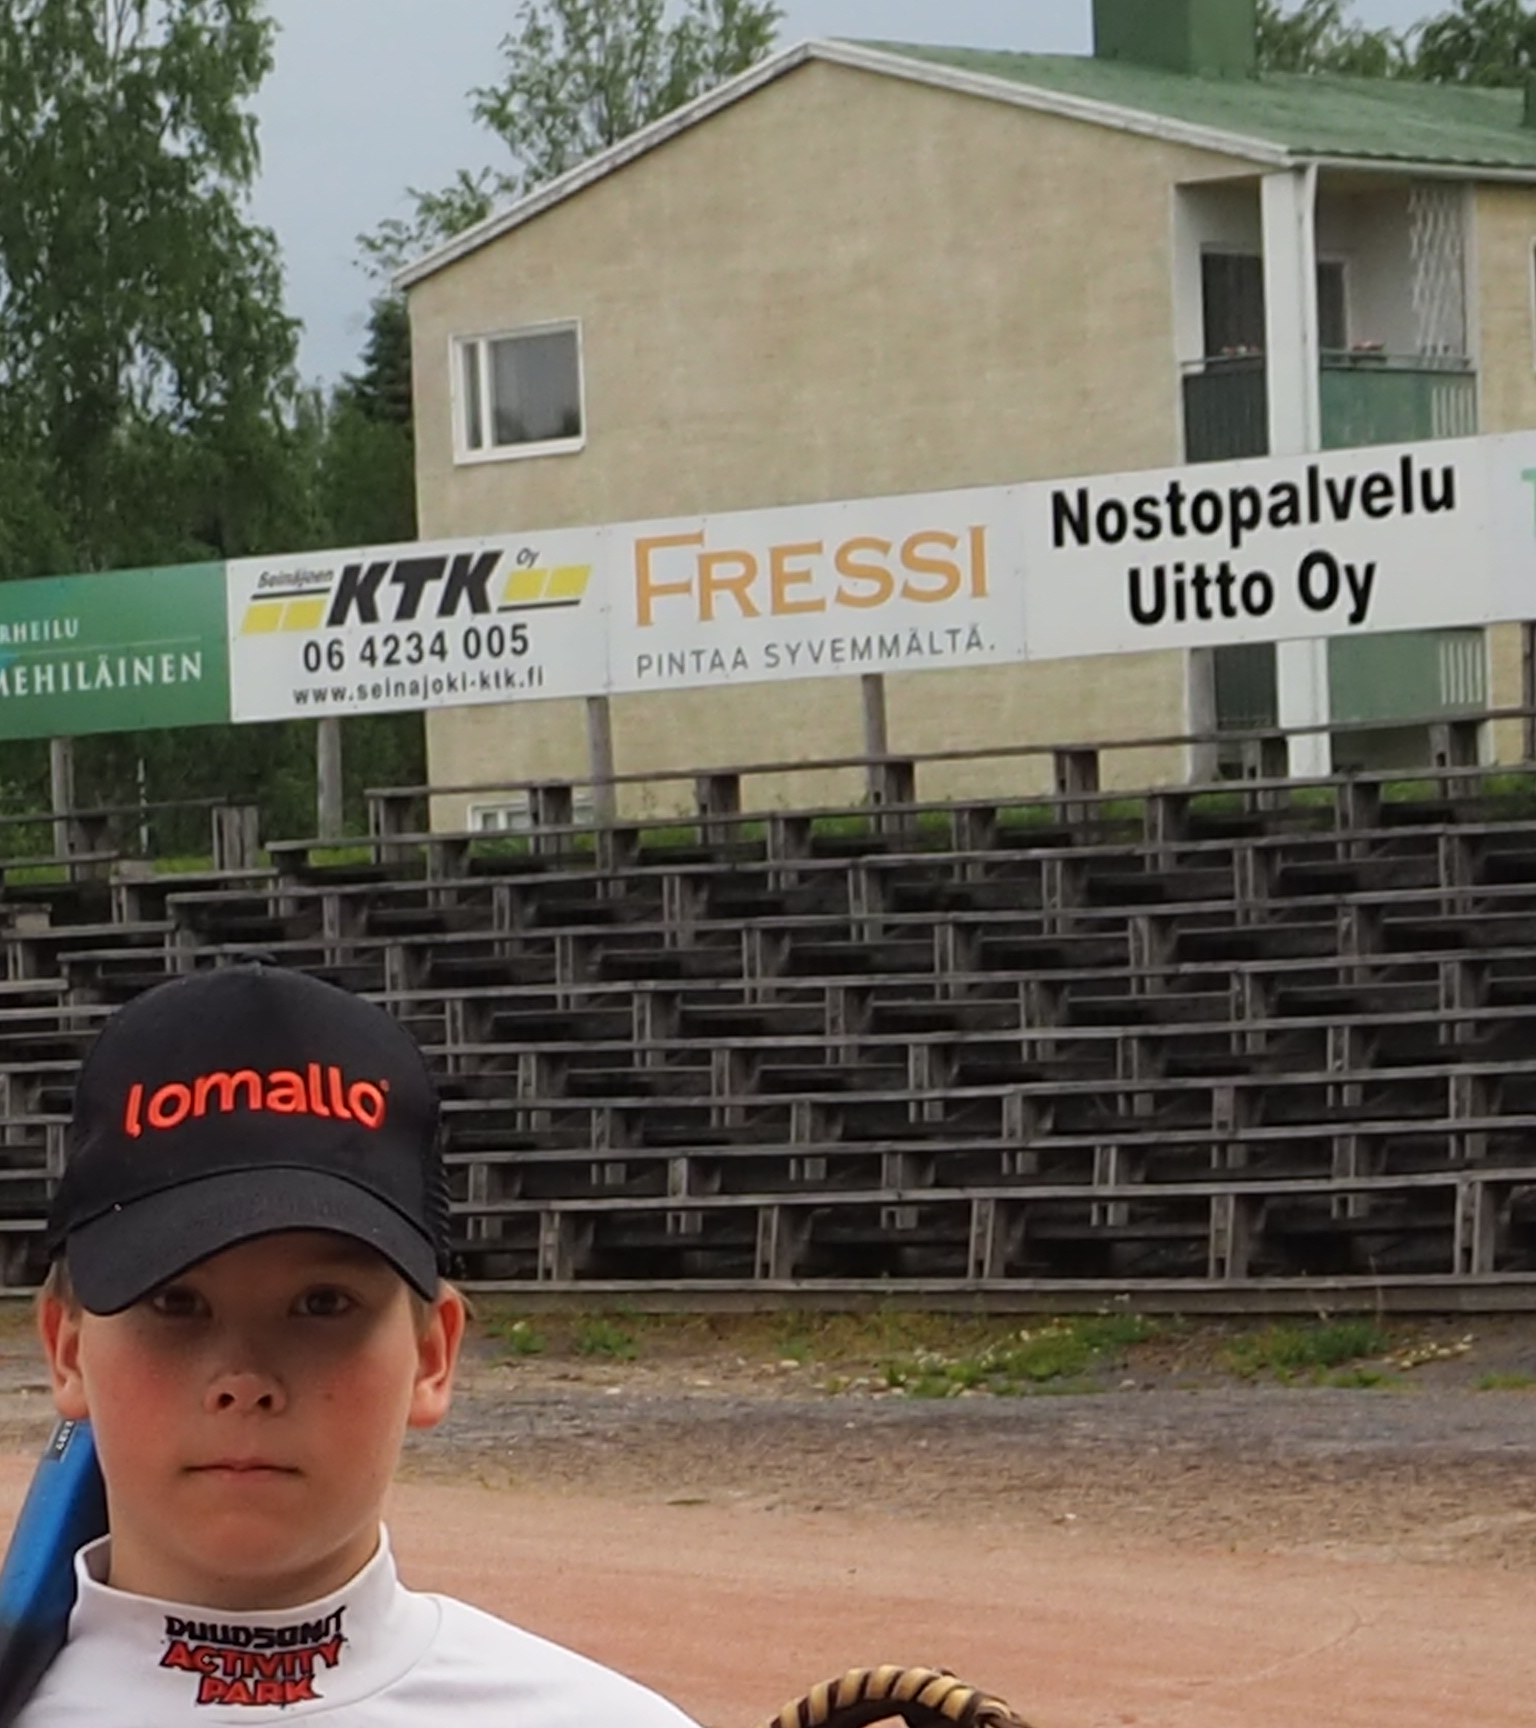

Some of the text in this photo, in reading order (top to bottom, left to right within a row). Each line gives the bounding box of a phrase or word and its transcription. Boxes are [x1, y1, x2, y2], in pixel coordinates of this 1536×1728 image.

[1052, 455, 1456, 548] Nostopalvelu
[326, 550, 504, 628] KTK
[517, 548, 540, 568] Oy
[634, 525, 990, 628] FRESSI
[1128, 550, 1376, 625] Uitto Oy
[303, 623, 528, 673] 06 4234 005
[636, 624, 996, 679] PINTAA SYVEMMÄLTÄ.
[292, 666, 543, 704] www.seinajoki-ktk.fi
[159, 1635, 347, 1678] ACTIVITY
[196, 1674, 322, 1706] PARK
